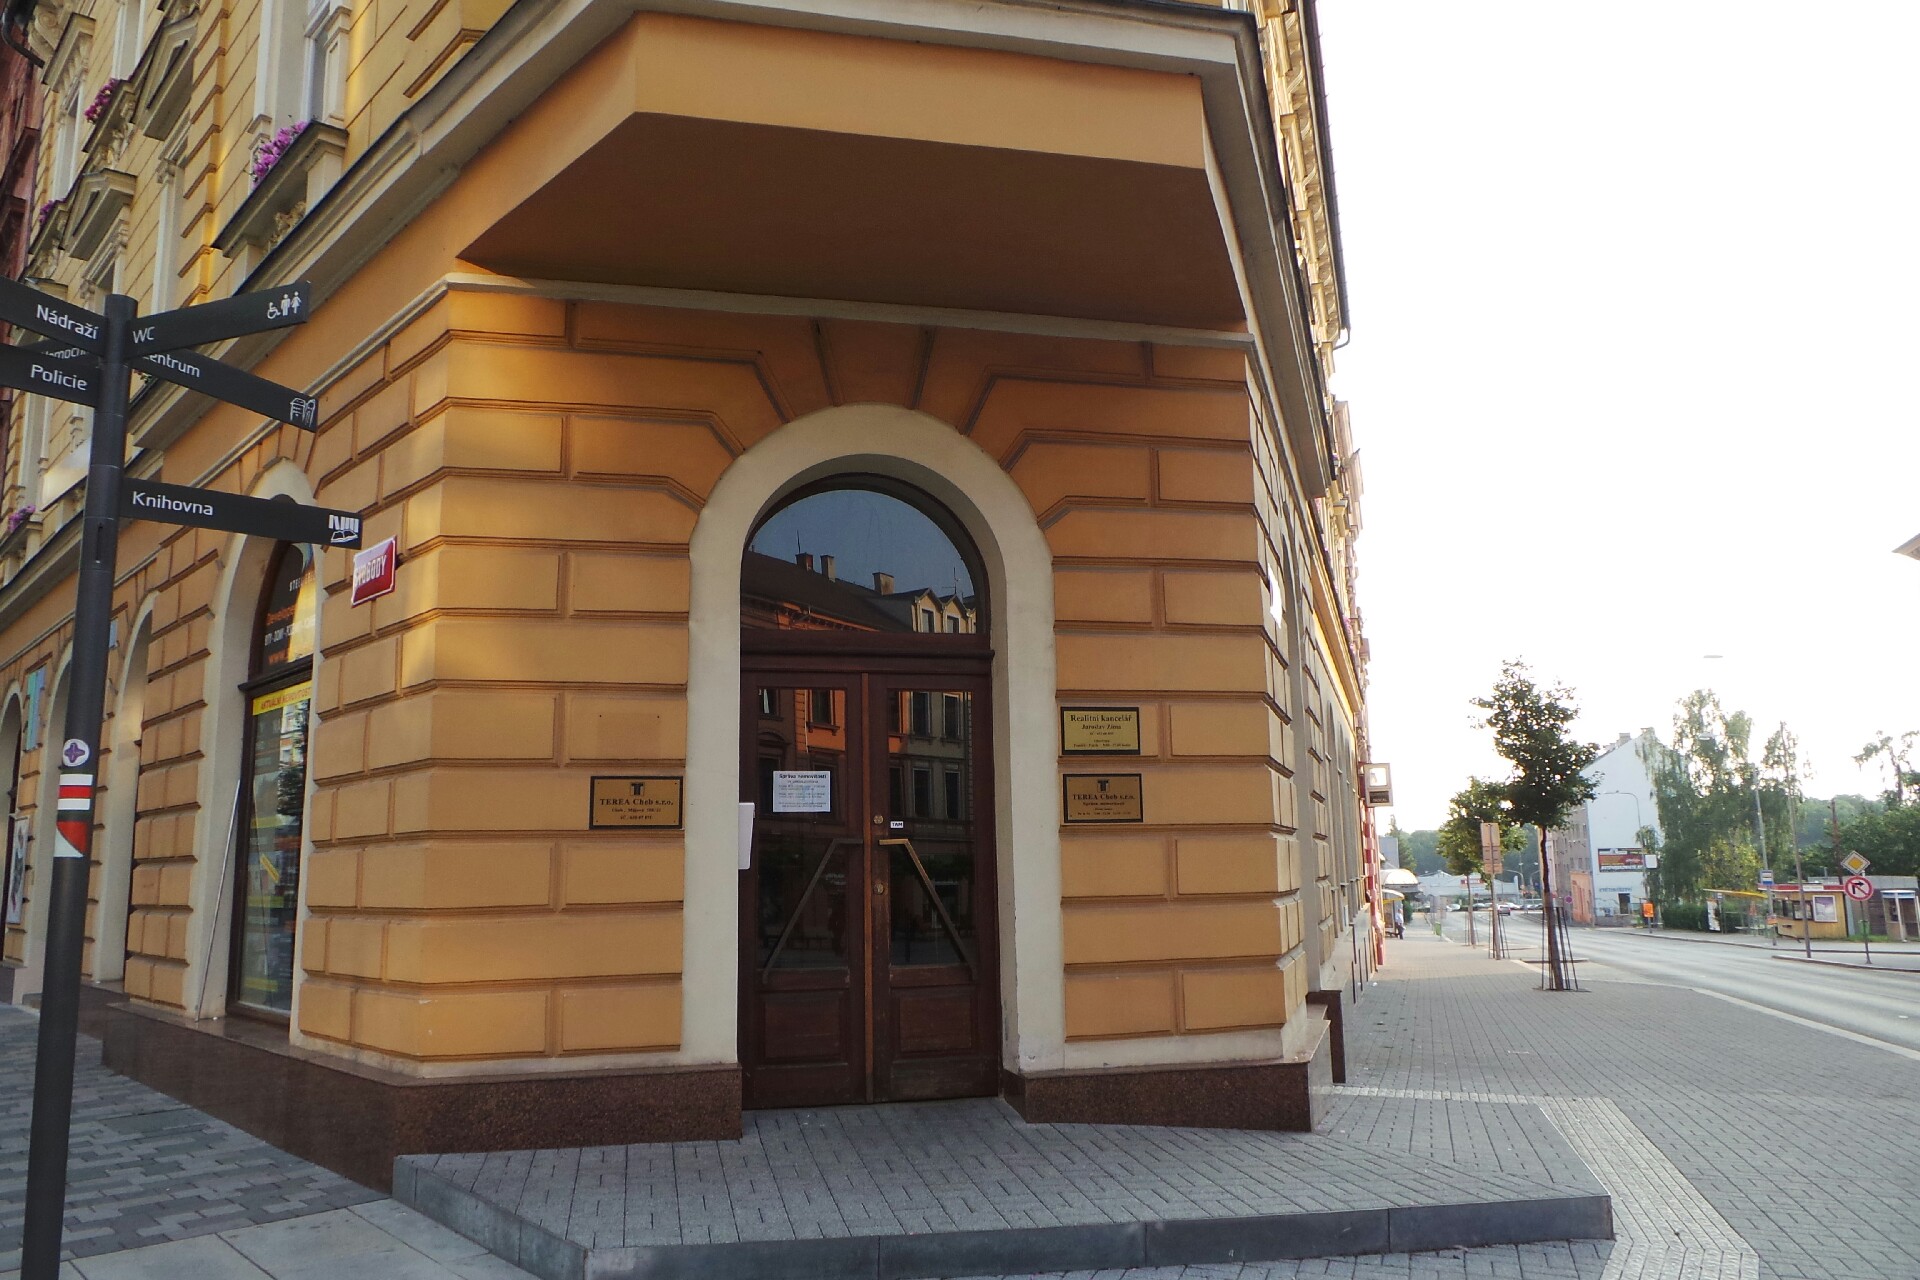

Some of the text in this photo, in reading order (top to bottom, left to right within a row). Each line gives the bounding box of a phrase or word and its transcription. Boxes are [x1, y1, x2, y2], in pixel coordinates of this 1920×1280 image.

[36, 304, 99, 339] Nádraží
[133, 326, 155, 344] WC
[30, 364, 88, 391] Policie
[132, 491, 214, 516] Knihovna
[1070, 714, 1132, 722] Realitní kancelář
[599, 798, 630, 806] TEREA
[632, 798, 654, 806] Cheb
